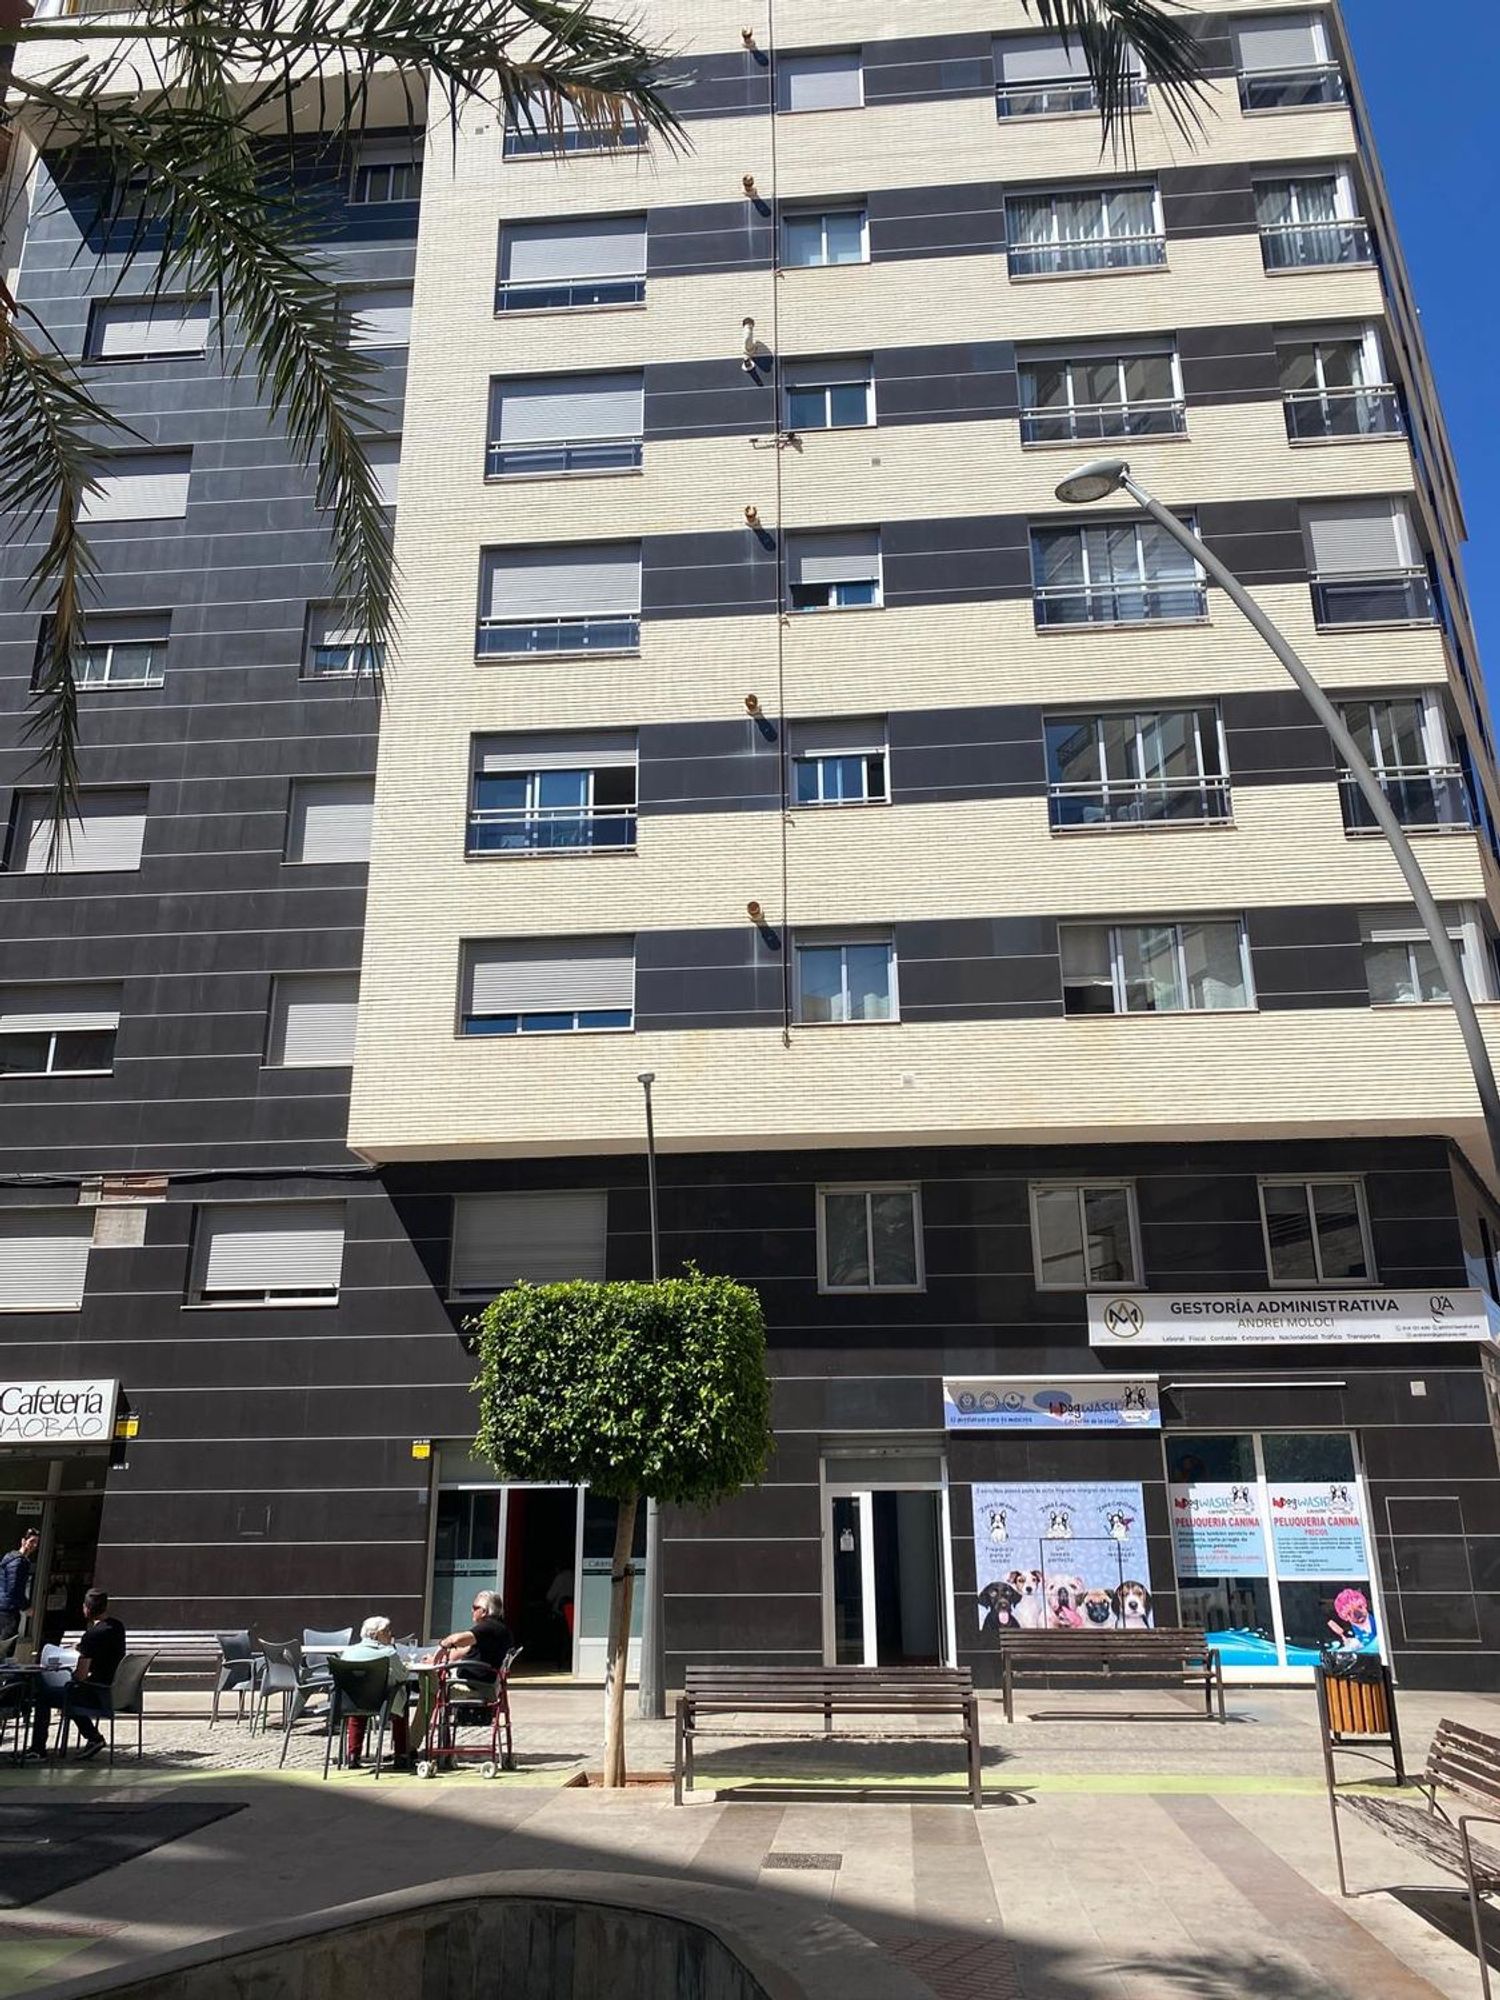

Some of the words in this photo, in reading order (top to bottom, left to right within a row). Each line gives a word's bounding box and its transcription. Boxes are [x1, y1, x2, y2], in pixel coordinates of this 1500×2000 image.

[1170, 1299, 1253, 1314] GESTORÍA
[1257, 1299, 1399, 1314] ADMINISTRATIVA
[1238, 1318, 1283, 1328] ANDREI
[1287, 1317, 1335, 1327] MOLOCI
[0, 1385, 103, 1416] Cafetería
[0, 1417, 103, 1438] AOBAO
[1228, 1517, 1260, 1527] CANINA
[1273, 1517, 1326, 1527] PELUQUERIA
[1327, 1516, 1360, 1526] CANINA
